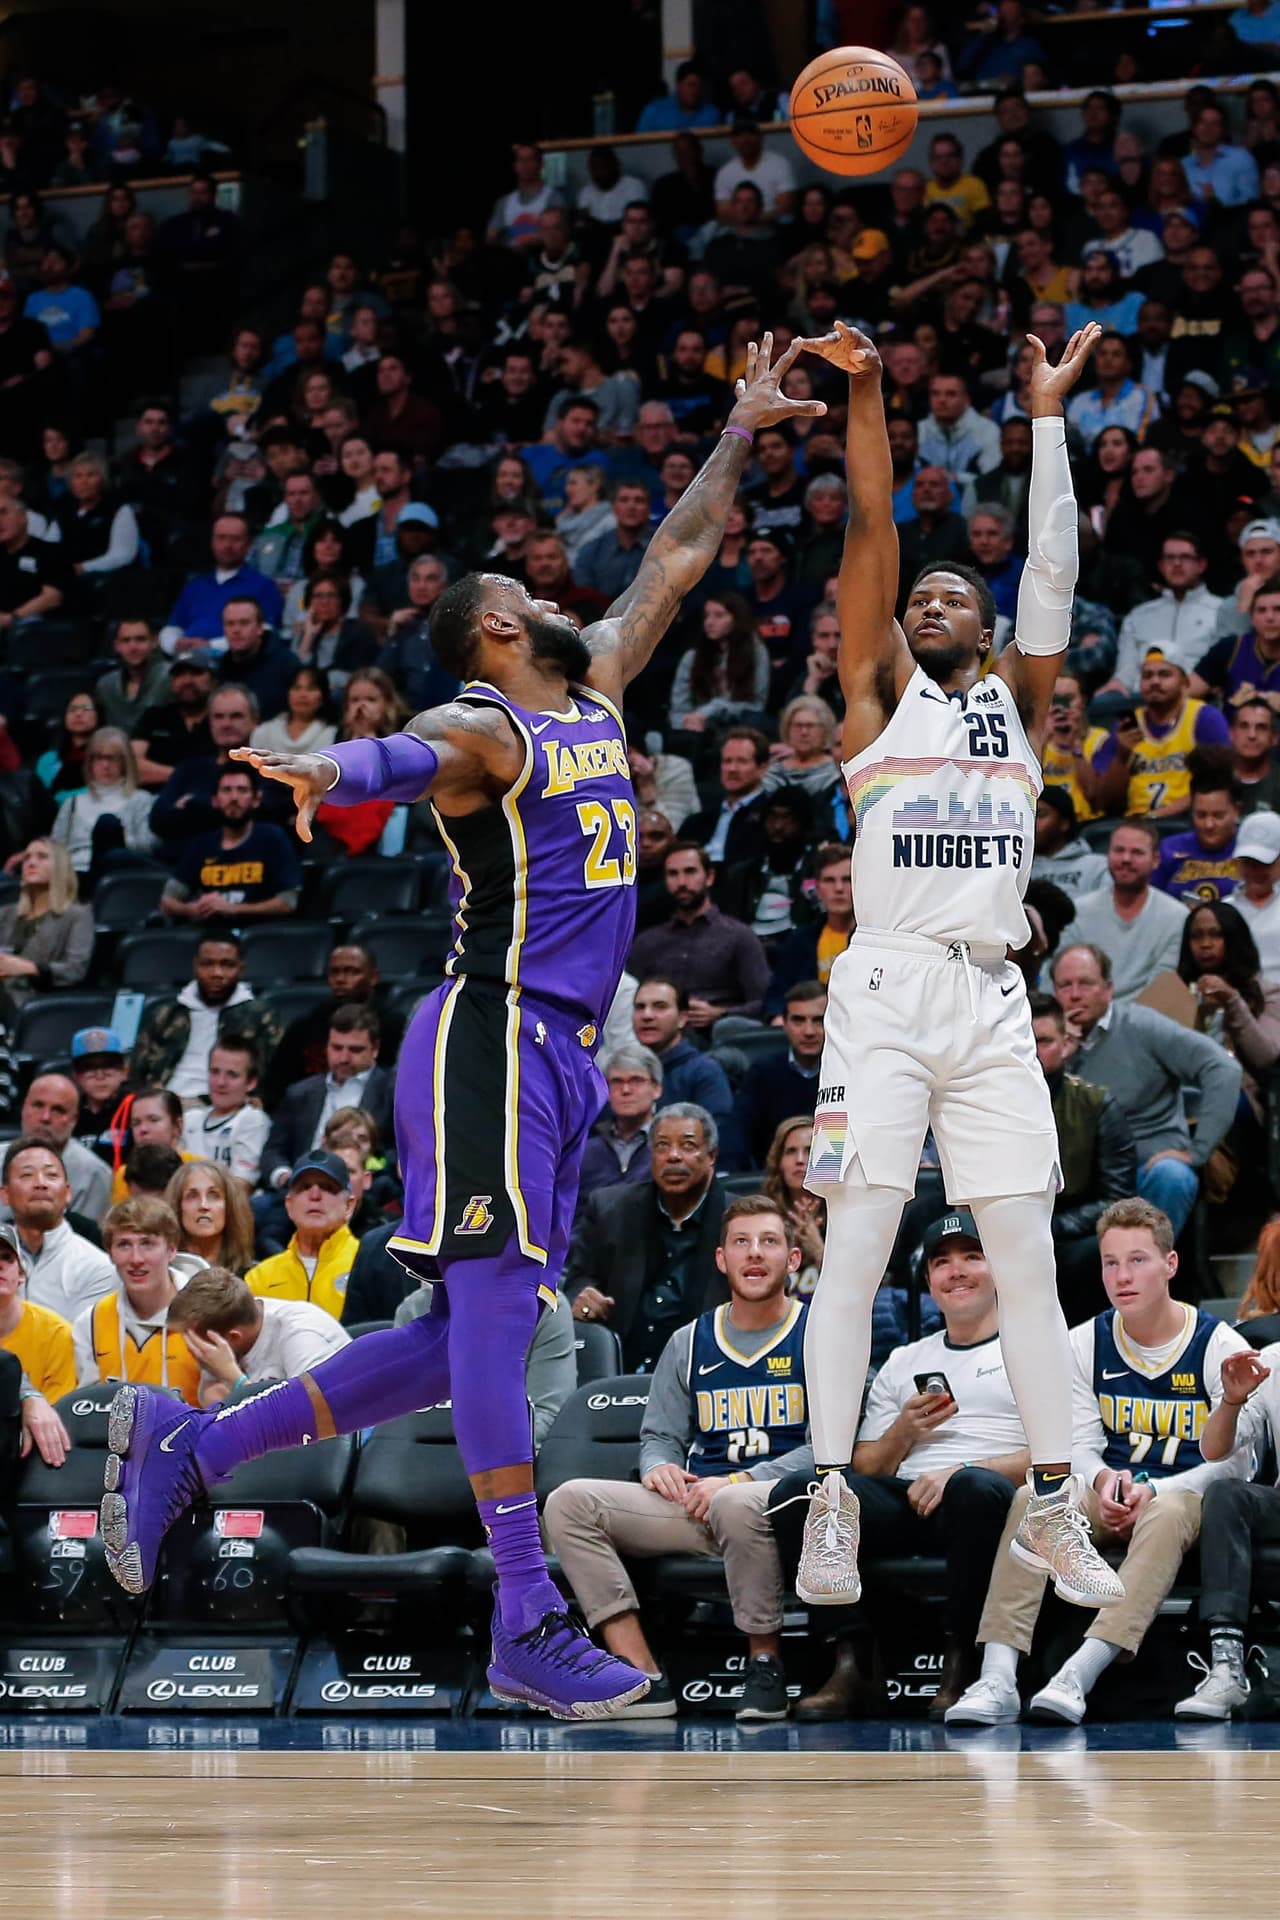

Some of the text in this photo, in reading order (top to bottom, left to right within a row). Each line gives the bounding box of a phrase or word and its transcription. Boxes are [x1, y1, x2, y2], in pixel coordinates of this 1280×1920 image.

[813, 77, 902, 109] SPALDING
[963, 712, 1009, 758] 25
[541, 739, 631, 799] LAKERS
[576, 799, 637, 889] 23
[892, 834, 1023, 870] NUGGETS
[766, 1356, 792, 1369] WU
[1171, 1373, 1195, 1387] WU
[611, 1396, 650, 1406] LEX
[695, 1383, 806, 1432] DENVER
[1098, 1393, 1209, 1440] DENVER
[41, 1560, 85, 1599] 59
[213, 1559, 254, 1591] 60
[19, 1656, 67, 1671] CLUB
[188, 1656, 236, 1671] CLUB
[363, 1656, 412, 1671] CLUB
[8, 1685, 88, 1697] LEXUS
[178, 1684, 260, 1697] LEXUS
[353, 1684, 436, 1698] LEXUS
[715, 1685, 802, 1697] LES
